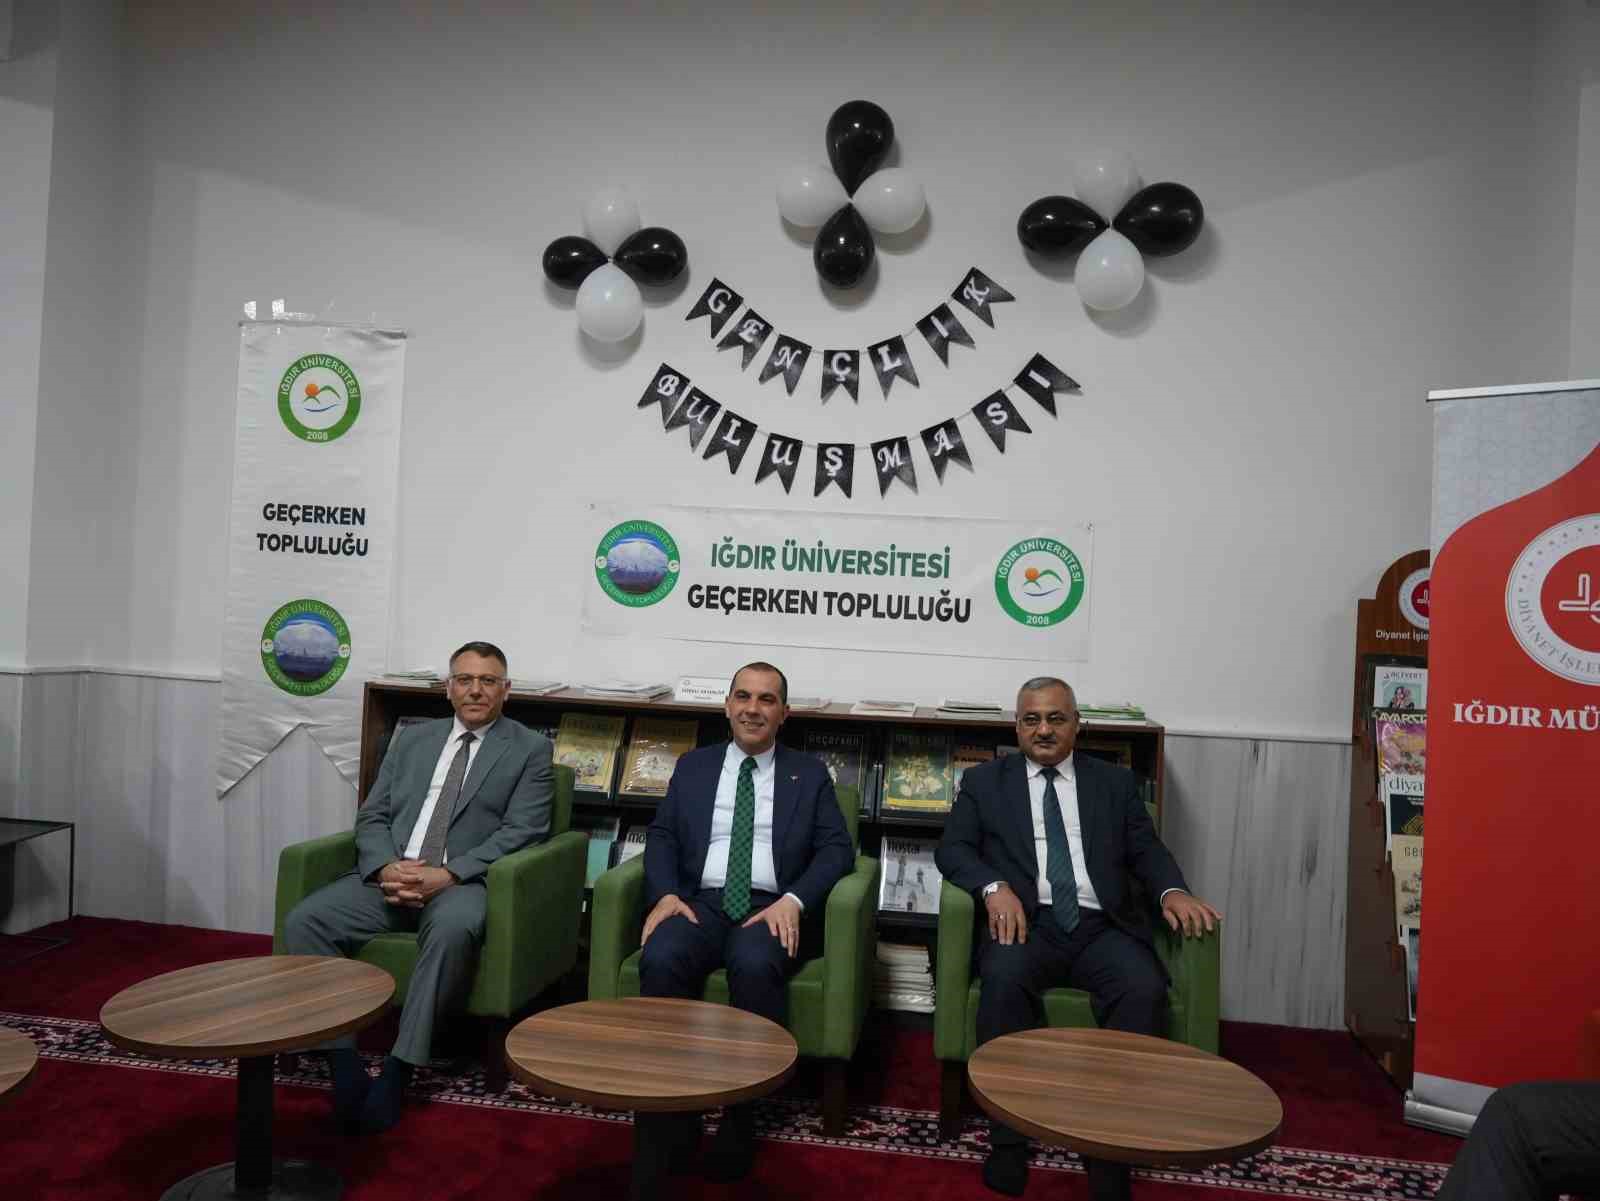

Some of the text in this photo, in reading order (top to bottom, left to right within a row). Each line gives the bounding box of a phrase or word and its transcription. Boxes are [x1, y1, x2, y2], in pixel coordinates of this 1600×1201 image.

[657, 368, 1051, 477] BULUŞMASI
[262, 502, 366, 526] GEÇERKEN
[256, 532, 369, 557] TOPLULUĞU
[711, 536, 951, 579] IĞDIR ÜNİVERSİTESİ
[687, 583, 972, 624] GEÇERKEN TOPLULUĞU
[1559, 650, 1600, 674] İŞLE
[1453, 700, 1600, 731] IĞDIR MÜ
